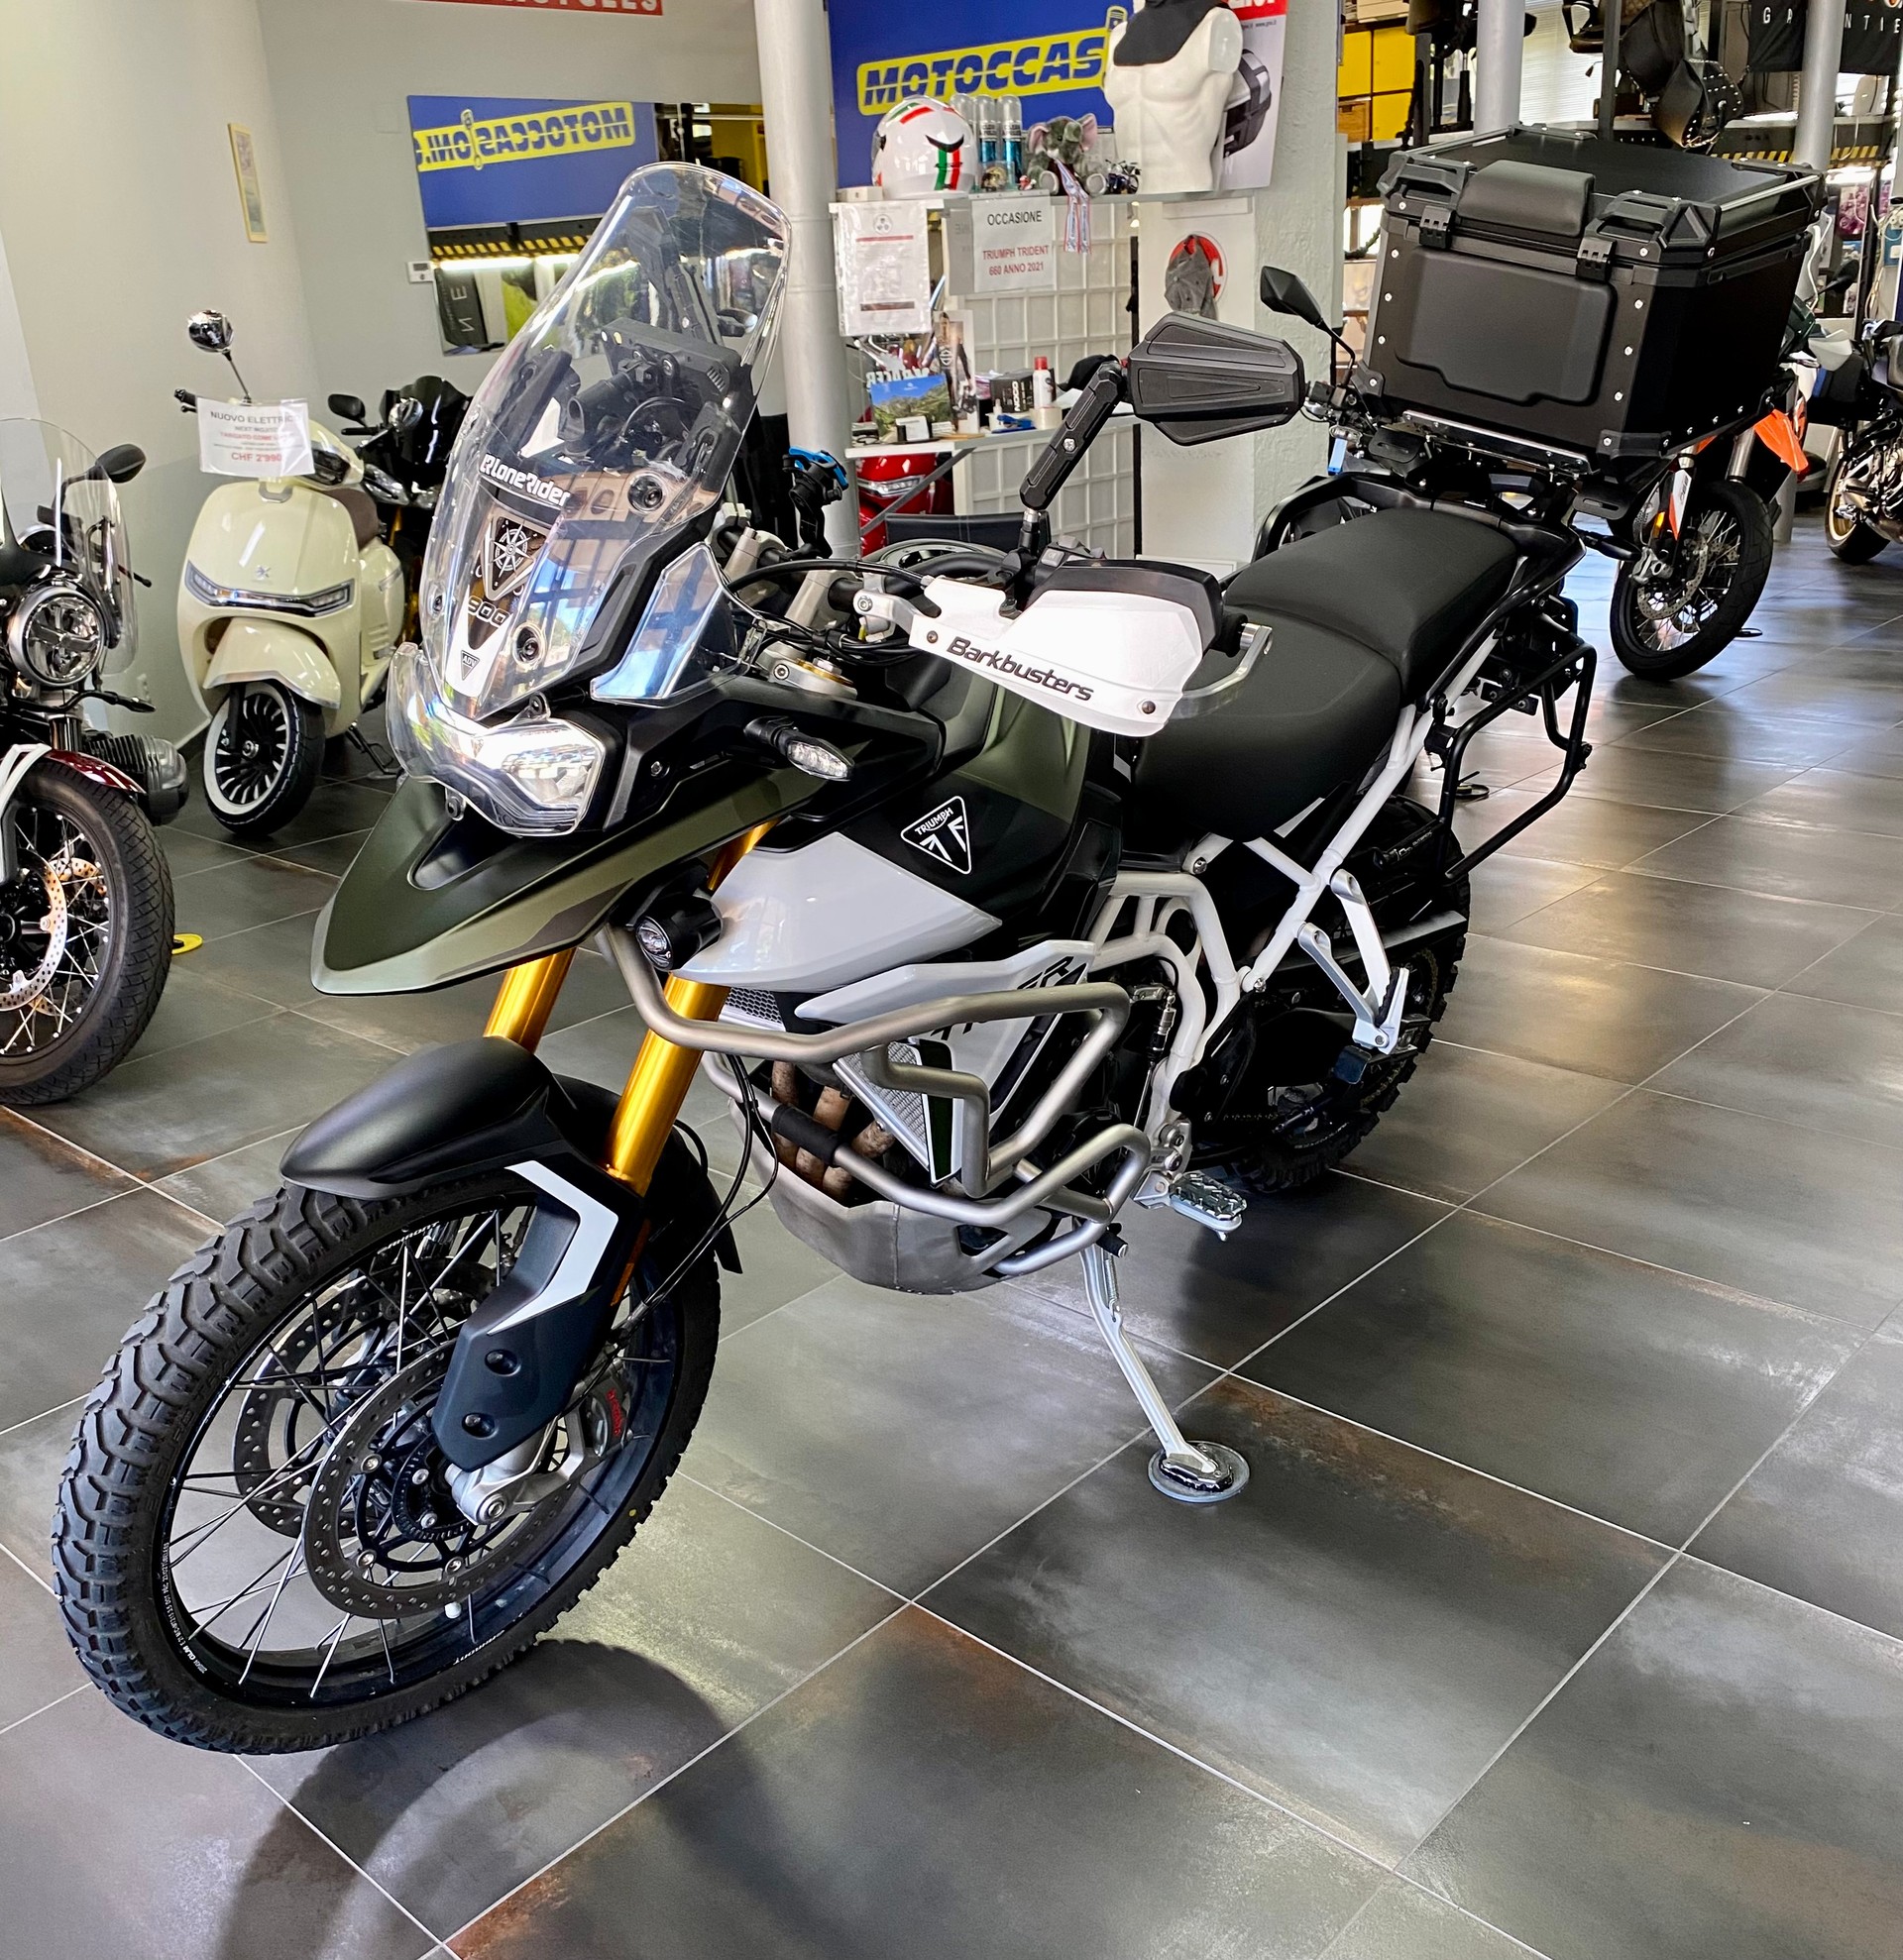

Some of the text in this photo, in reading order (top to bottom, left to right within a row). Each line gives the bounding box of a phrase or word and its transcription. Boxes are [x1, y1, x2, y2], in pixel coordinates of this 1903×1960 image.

[987, 210, 1043, 226] OCCASIONE
[982, 245, 1050, 260] TRIUMPH TRIDENT
[989, 262, 1045, 275] 660 ANNO 2021
[1011, 381, 1021, 412] NOCO
[210, 411, 299, 425] NUOVO ELETTRIC
[231, 452, 254, 462] CHF
[467, 595, 510, 627] 900
[462, 652, 479, 668] ADV
[947, 636, 1094, 702] Barkbusters
[914, 807, 954, 836] TRIUMPH
